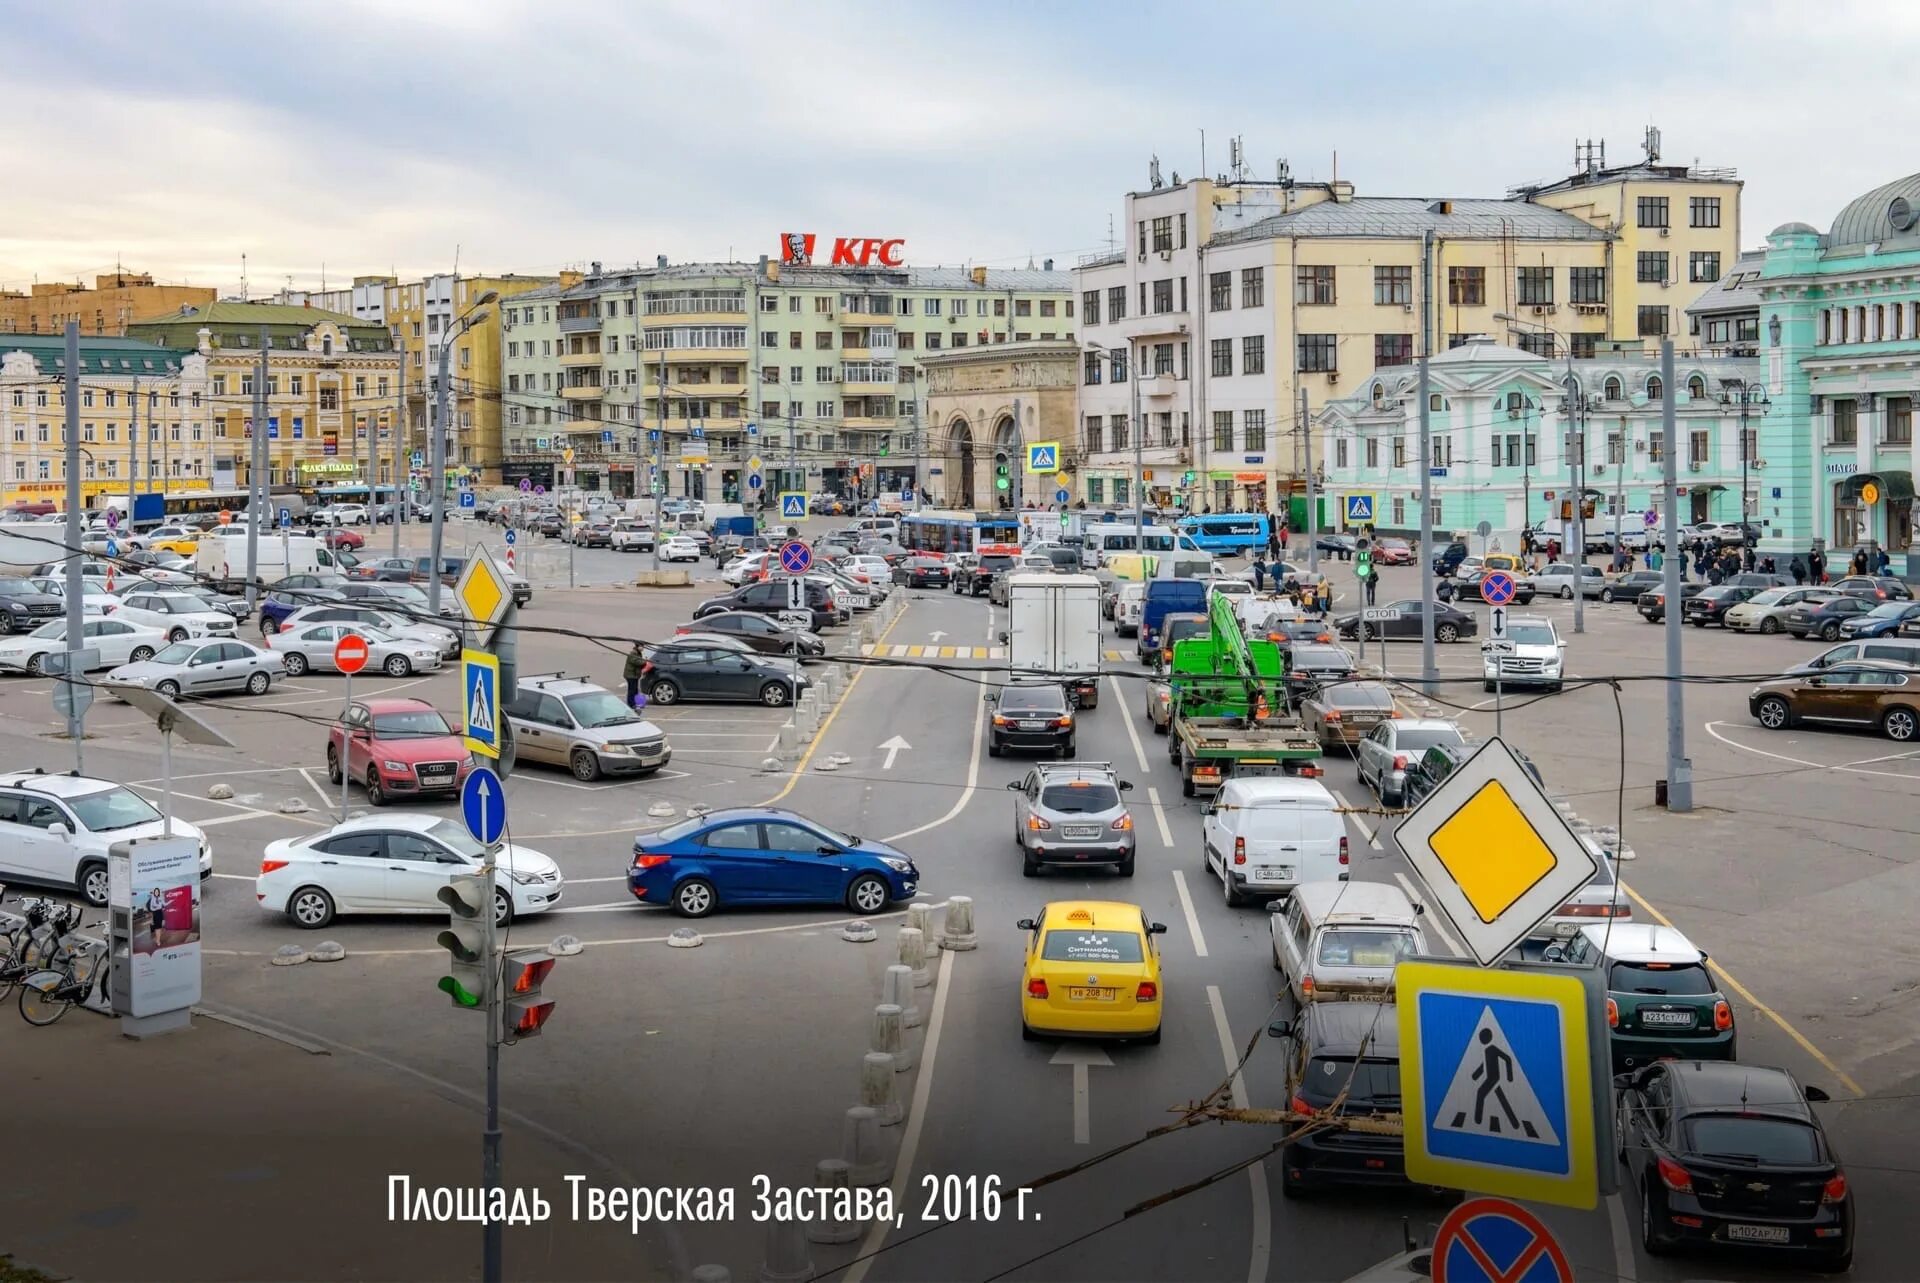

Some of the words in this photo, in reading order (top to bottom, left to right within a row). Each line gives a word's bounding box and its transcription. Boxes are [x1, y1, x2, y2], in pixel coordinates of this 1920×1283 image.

[831, 238, 905, 267] KFC
[837, 596, 865, 606] СТОП
[1366, 609, 1397, 619] СТОП
[1068, 946, 1119, 954] Ситимобил
[1086, 988, 1101, 997] 208
